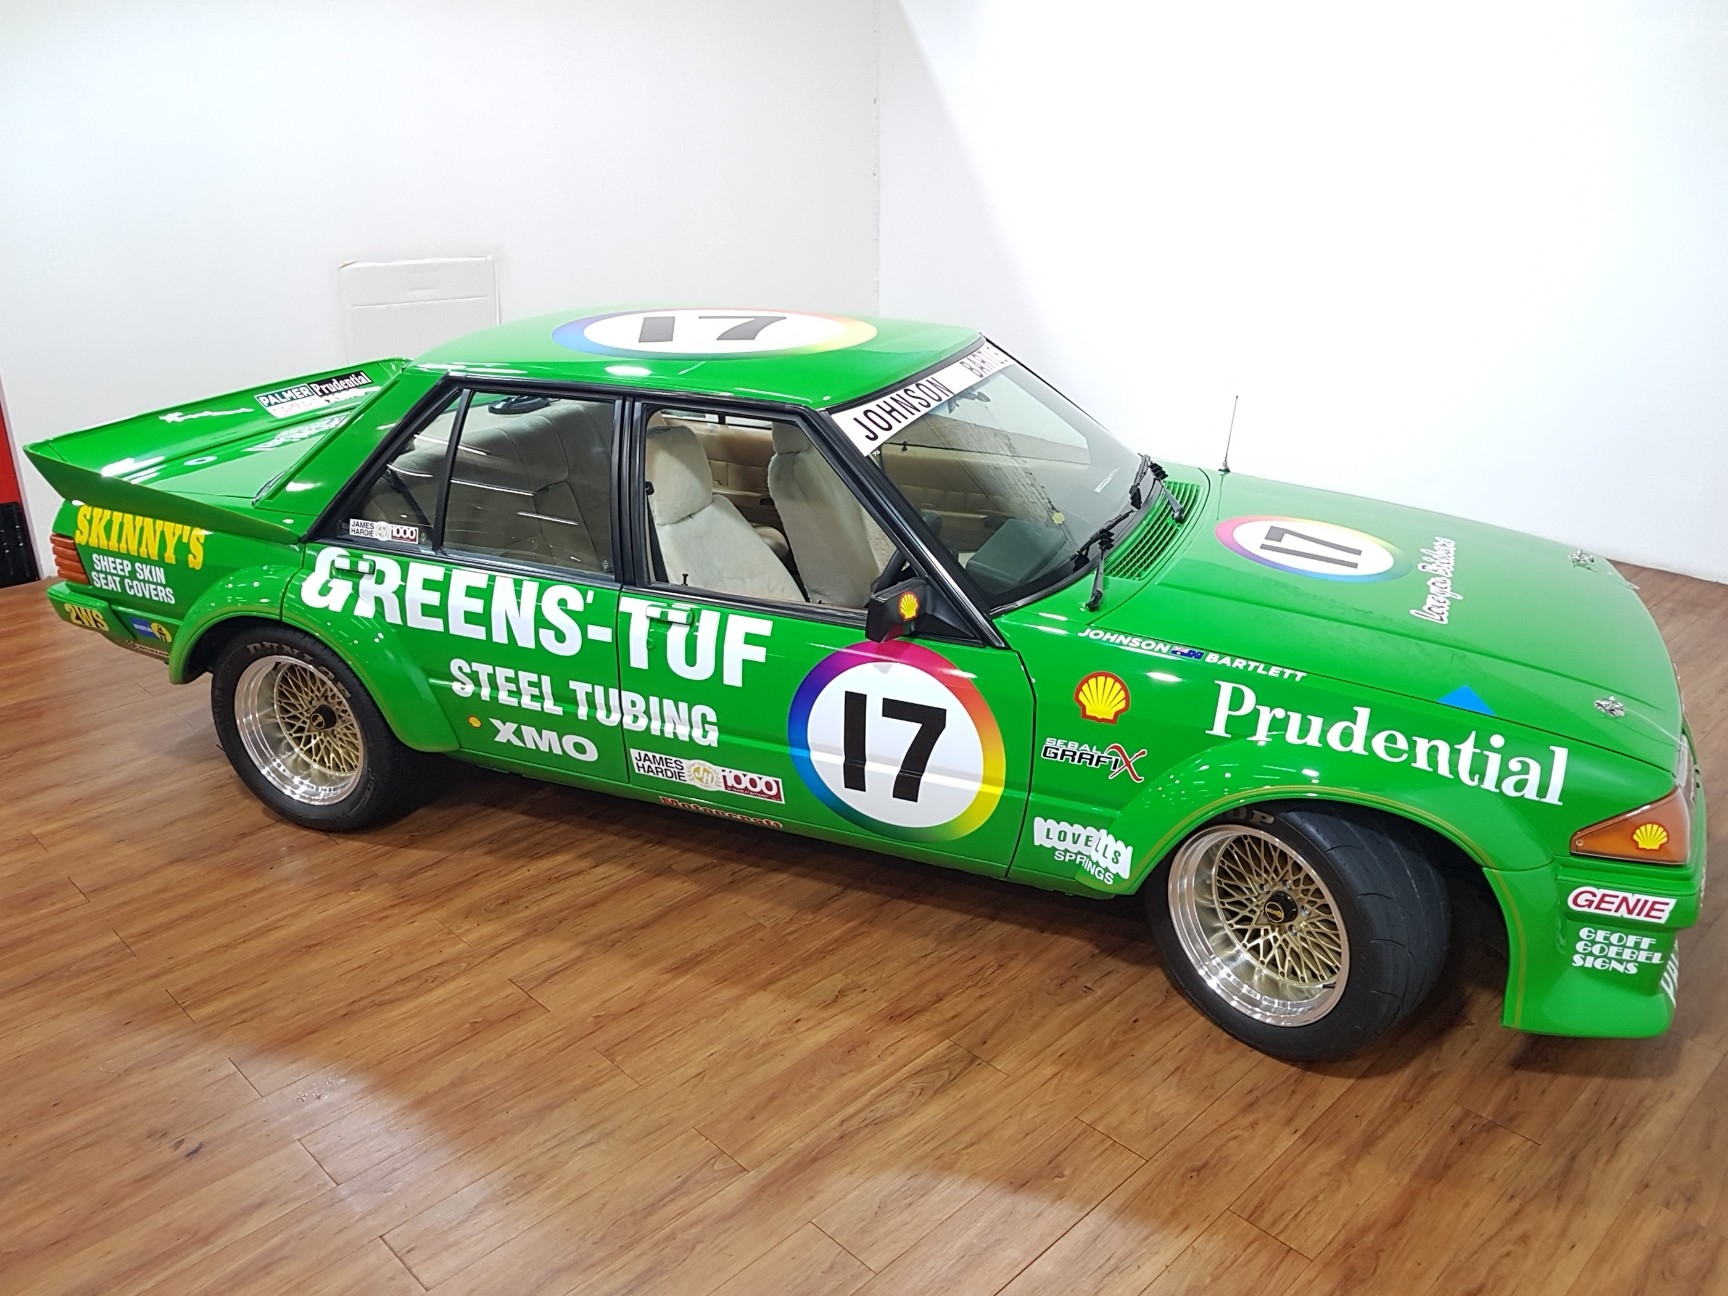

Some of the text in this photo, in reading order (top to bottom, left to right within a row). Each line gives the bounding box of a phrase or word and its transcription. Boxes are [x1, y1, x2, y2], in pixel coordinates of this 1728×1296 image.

[638, 316, 787, 343] 17
[258, 371, 372, 407] PALMER Prudential
[853, 376, 954, 441] JOHNSON
[74, 504, 205, 570] SKINNY'S
[351, 520, 375, 530] JAMES
[351, 528, 374, 537] HARDIE
[391, 526, 417, 539] 1000
[1260, 525, 1362, 569] 17
[92, 554, 166, 584] SHEEP SKIN
[92, 572, 175, 604] SEAT COVERS
[64, 603, 109, 632] 2WS
[1078, 628, 1307, 682] JOHNSON BARTLETT
[450, 658, 719, 747] STEEL TUBING
[489, 718, 598, 762] XMO
[843, 690, 947, 803] 17
[1045, 738, 1102, 755] SEBAL
[1205, 680, 1568, 805] Prudential
[635, 752, 685, 771] JAMES
[636, 762, 687, 782] HARDIE
[1041, 743, 1147, 783] GRAFIX
[721, 770, 778, 796] 1000
[1043, 825, 1124, 868] LOVELLS
[1054, 851, 1114, 885] SPRINGS
[1571, 889, 1670, 920] GENIE
[1576, 941, 1664, 963] GOEBEL
[1579, 927, 1656, 949] GEOFF
[1572, 954, 1638, 974] SIGNS
